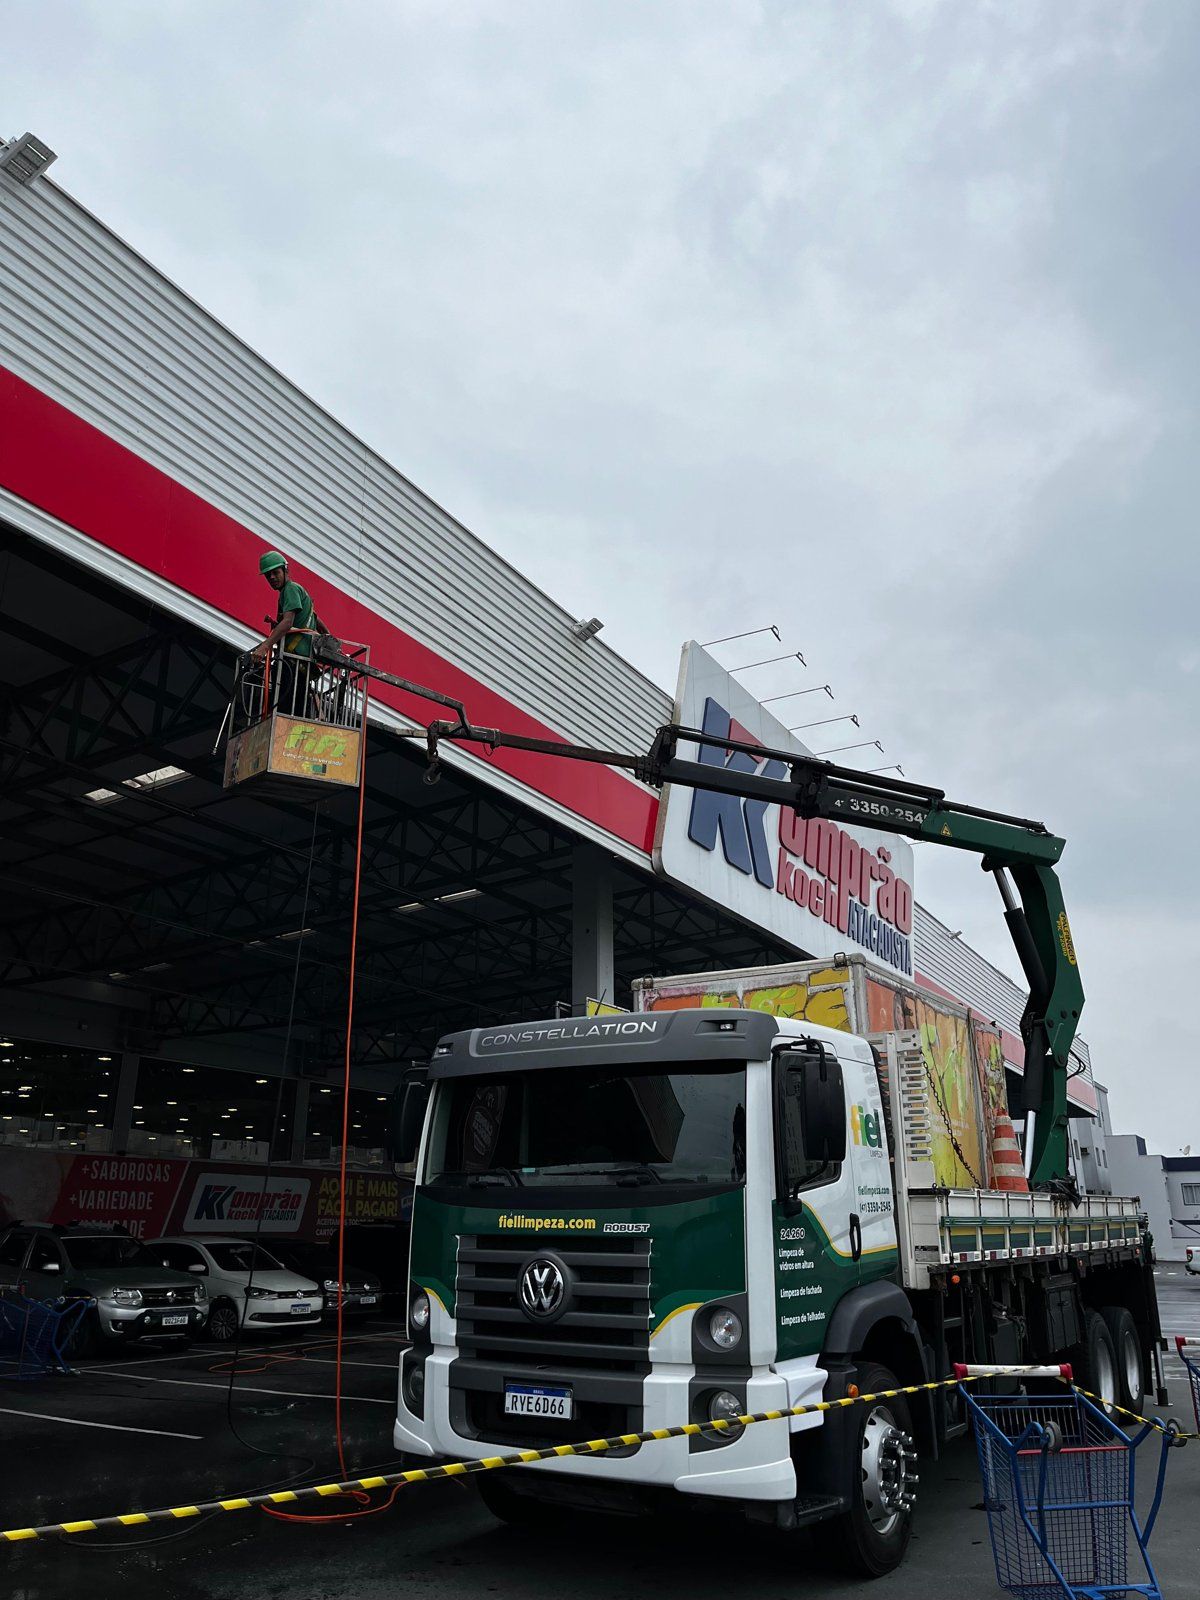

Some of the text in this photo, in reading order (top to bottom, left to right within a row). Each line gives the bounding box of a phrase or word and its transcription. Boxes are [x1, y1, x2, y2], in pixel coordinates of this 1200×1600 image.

[850, 798, 927, 824] 3350-254
[847, 900, 912, 976] ATACADISTA
[481, 1021, 657, 1047] CONSTELLATION
[850, 1104, 882, 1148] fiel
[367, 1180, 399, 1197] MAIS
[498, 1214, 596, 1231] fiellimpeza.com
[603, 1223, 650, 1234] ROBUST
[778, 1247, 804, 1259] Limpeza de
[779, 1262, 795, 1271] vidros
[802, 1260, 814, 1269] altura
[780, 1285, 822, 1299] Limpeza de fachada
[781, 1311, 825, 1326] Limpeza de Telhados
[511, 1395, 564, 1415] RYE6D66
